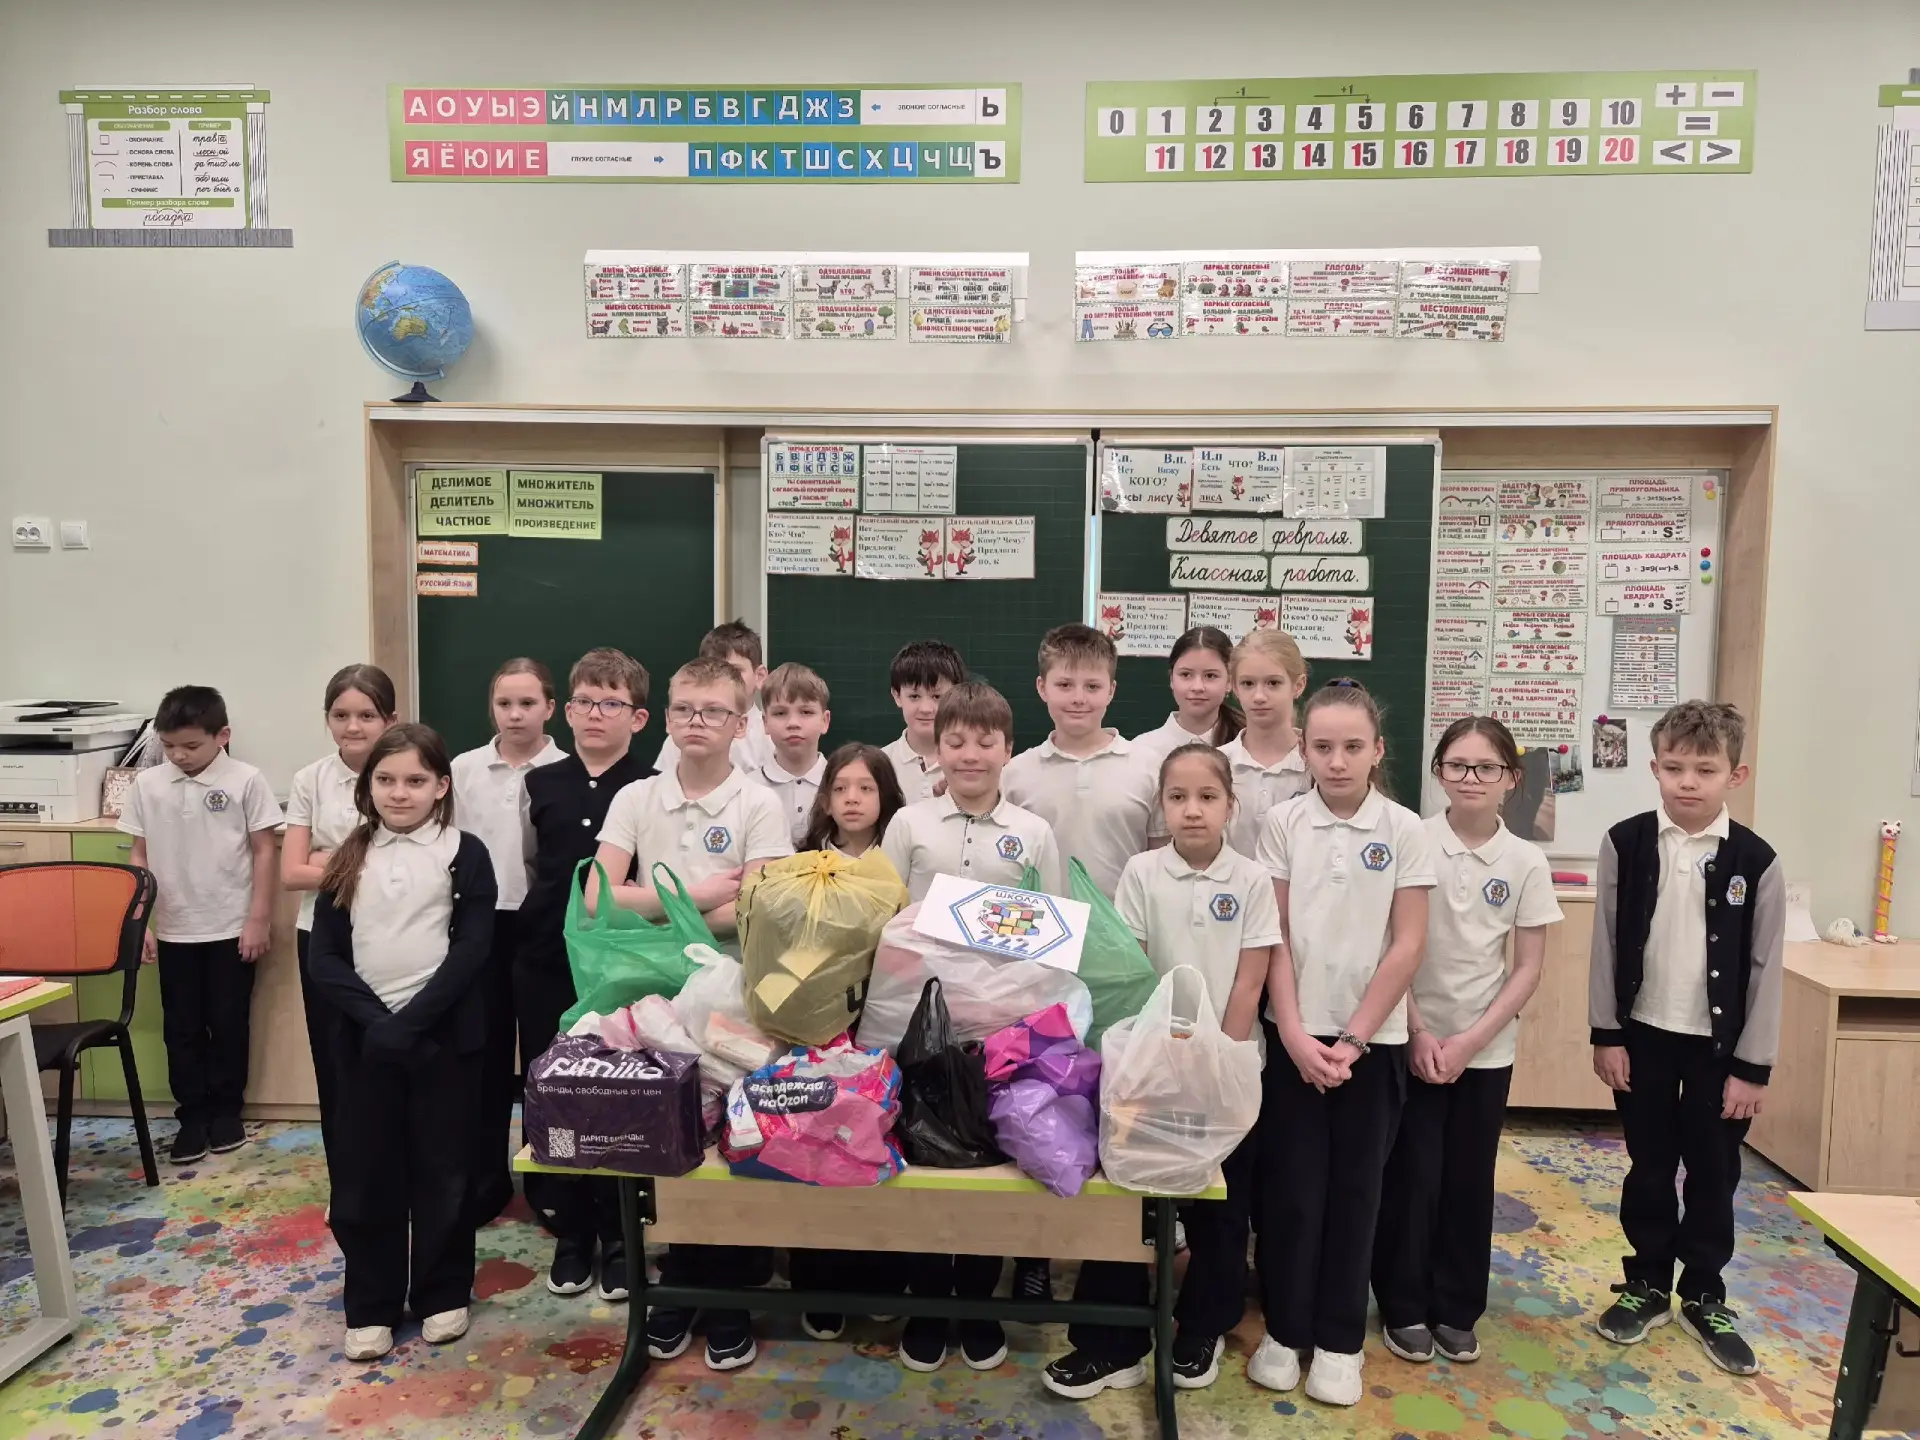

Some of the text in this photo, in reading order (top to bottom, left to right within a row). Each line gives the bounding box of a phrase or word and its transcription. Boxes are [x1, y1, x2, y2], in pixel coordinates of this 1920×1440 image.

[129, 106, 202, 116] Разбор слова
[409, 94, 854, 120] А О У Ы Э Й Н М Л Р Б В Г Д Ж З
[1110, 100, 1634, 134] 0 1 2 3 4 5 6 7 8 9 10
[412, 144, 540, 168] Я Ё Ю И Е
[1155, 137, 1634, 169] 11 12 13 14 15 16 17 18 19 20
[695, 147, 1001, 171] П Ф К Т Ш С Х Ц Ч Щ Ъ
[1420, 305, 1486, 314] МЕСТОИМЕНИЯ
[1164, 454, 1186, 463] В.п.
[1202, 451, 1222, 461] И.п
[1258, 452, 1277, 461] В.п
[1229, 460, 1253, 468] ЧТО?
[1258, 464, 1280, 472] Вижу
[1158, 467, 1179, 476] Вижу
[432, 477, 491, 489] ДЕЛИМОЕ
[518, 479, 595, 491] МНОЖИТЕЛЬ
[1130, 477, 1167, 486] КОГО?
[430, 496, 494, 508] ДЕЛИТЕЛЬ
[517, 498, 594, 510] МНОЖИТЕЛЬ
[1148, 494, 1174, 504] лису
[436, 516, 491, 526] ЧАСТНОЕ
[515, 519, 596, 530] ПРОИЗВЕДЕНИЕ
[1176, 519, 1352, 553] Девятое февраля.
[1663, 527, 1673, 538] S
[424, 549, 470, 557] МАТЕМАТИКА
[1171, 557, 1358, 590] Классная работа.
[452, 580, 472, 588] ЯЗЫК
[1664, 599, 1673, 610] S
[996, 891, 1039, 904] ШКОЛА
[977, 929, 1030, 954] 222
[537, 1084, 573, 1095] Бренды,
[576, 1086, 628, 1095] свободные
